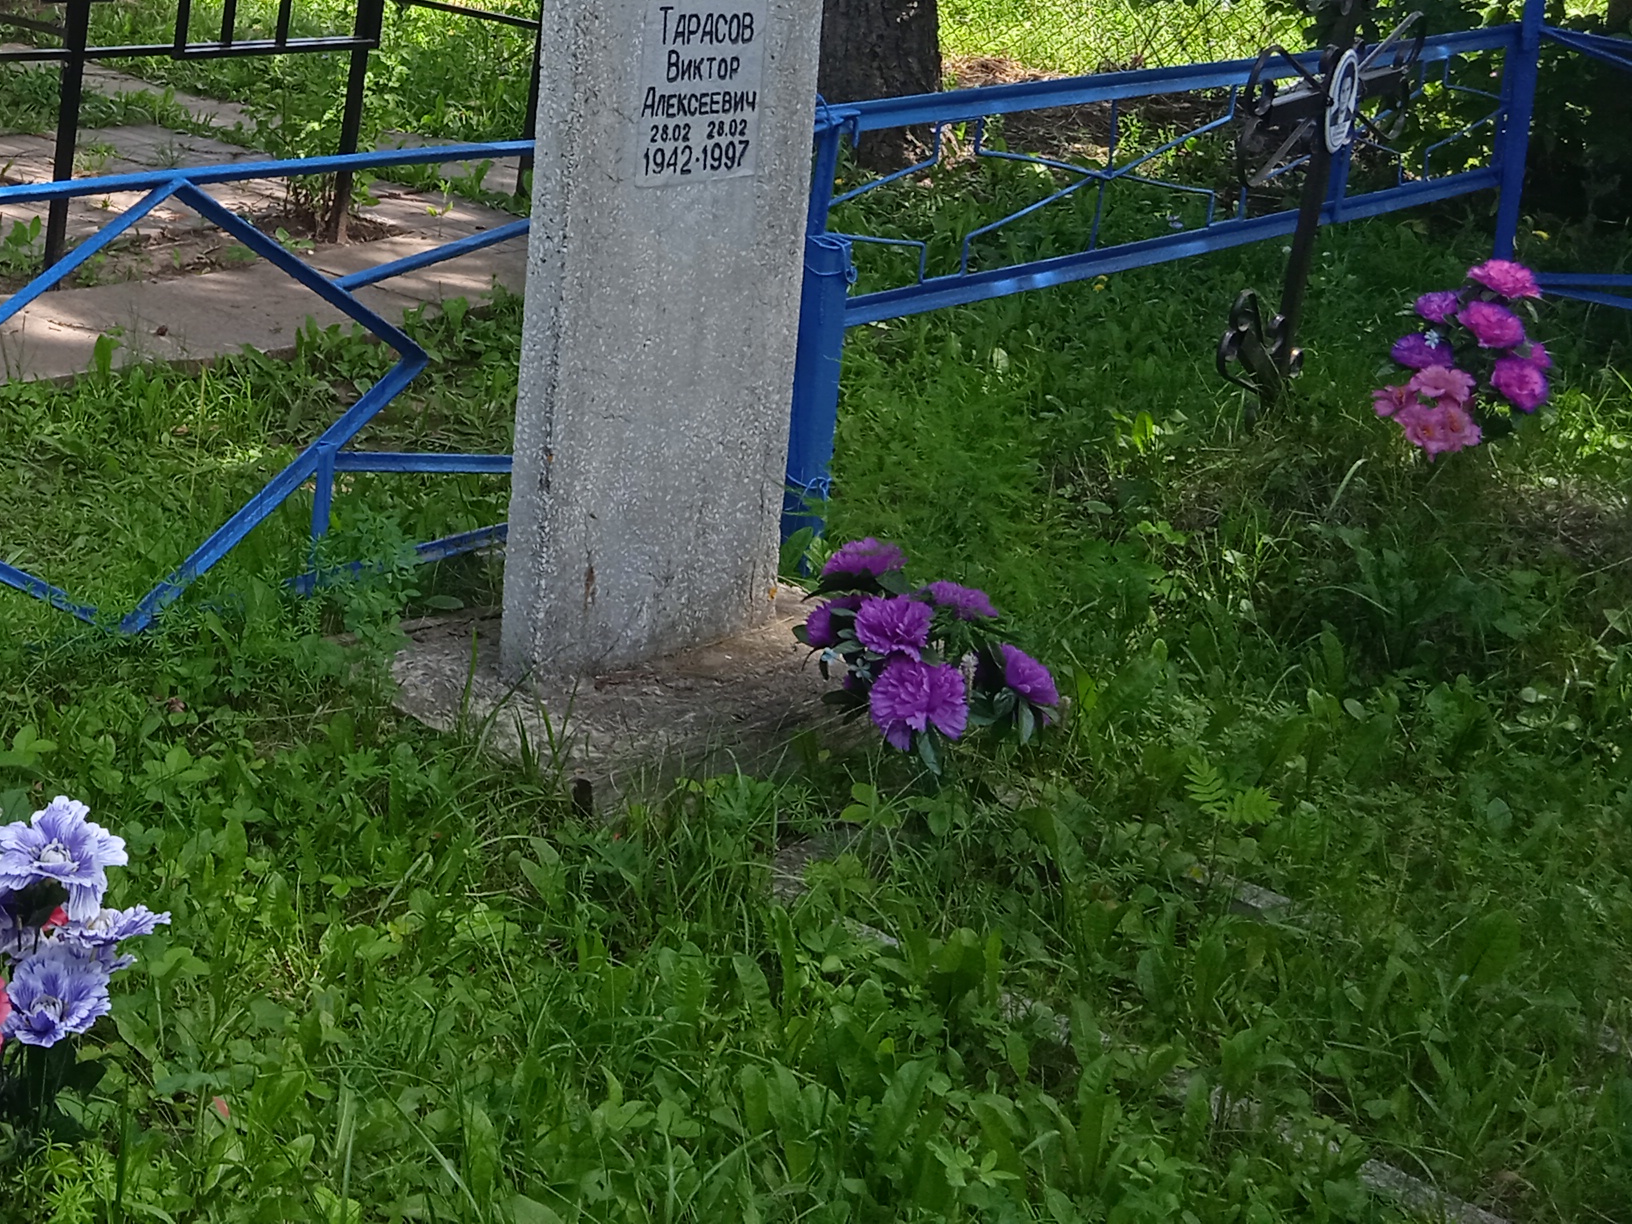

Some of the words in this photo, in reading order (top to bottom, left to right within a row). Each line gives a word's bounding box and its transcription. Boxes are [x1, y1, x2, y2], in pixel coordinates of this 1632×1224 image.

[659, 5, 755, 46] ТАРАСОВ
[666, 49, 741, 83] ВИКТОР
[640, 86, 757, 118] АЛЕКСЕЕВИЧ
[650, 122, 691, 144] 28.02
[706, 118, 748, 140] 28.02
